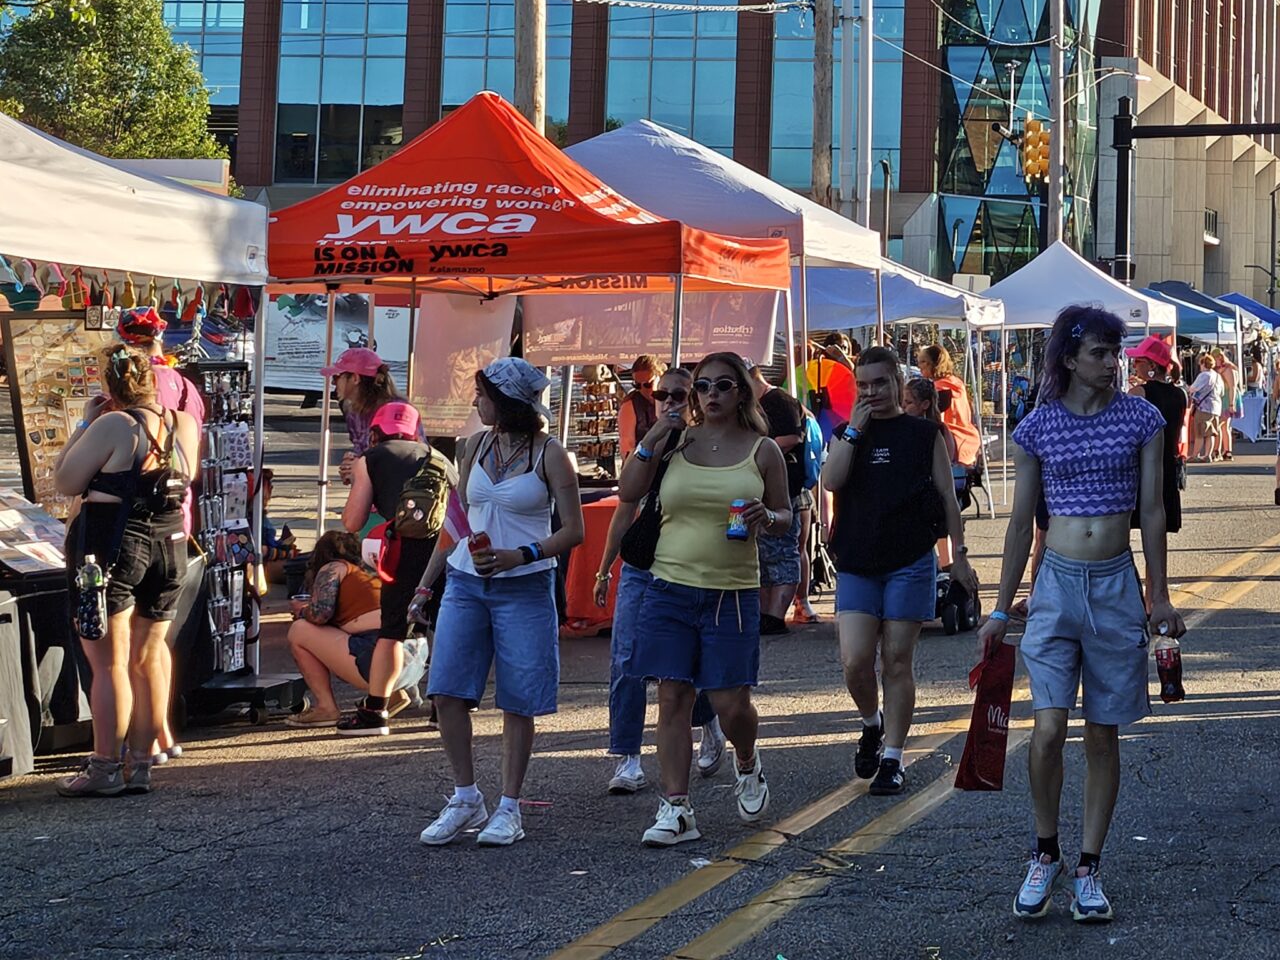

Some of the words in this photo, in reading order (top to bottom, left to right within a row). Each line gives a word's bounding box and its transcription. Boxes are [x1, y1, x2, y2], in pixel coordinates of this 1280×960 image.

[346, 181, 478, 198] eliminating
[485, 183, 561, 198] racism
[339, 196, 486, 212] empowering
[495, 198, 576, 213] women
[323, 211, 537, 239] ywca
[314, 246, 336, 262] IS
[341, 246, 377, 262] ON
[383, 245, 401, 260] A
[428, 242, 509, 263] ywca
[313, 259, 415, 275] MISSION
[428, 266, 486, 274] Kalamazoo
